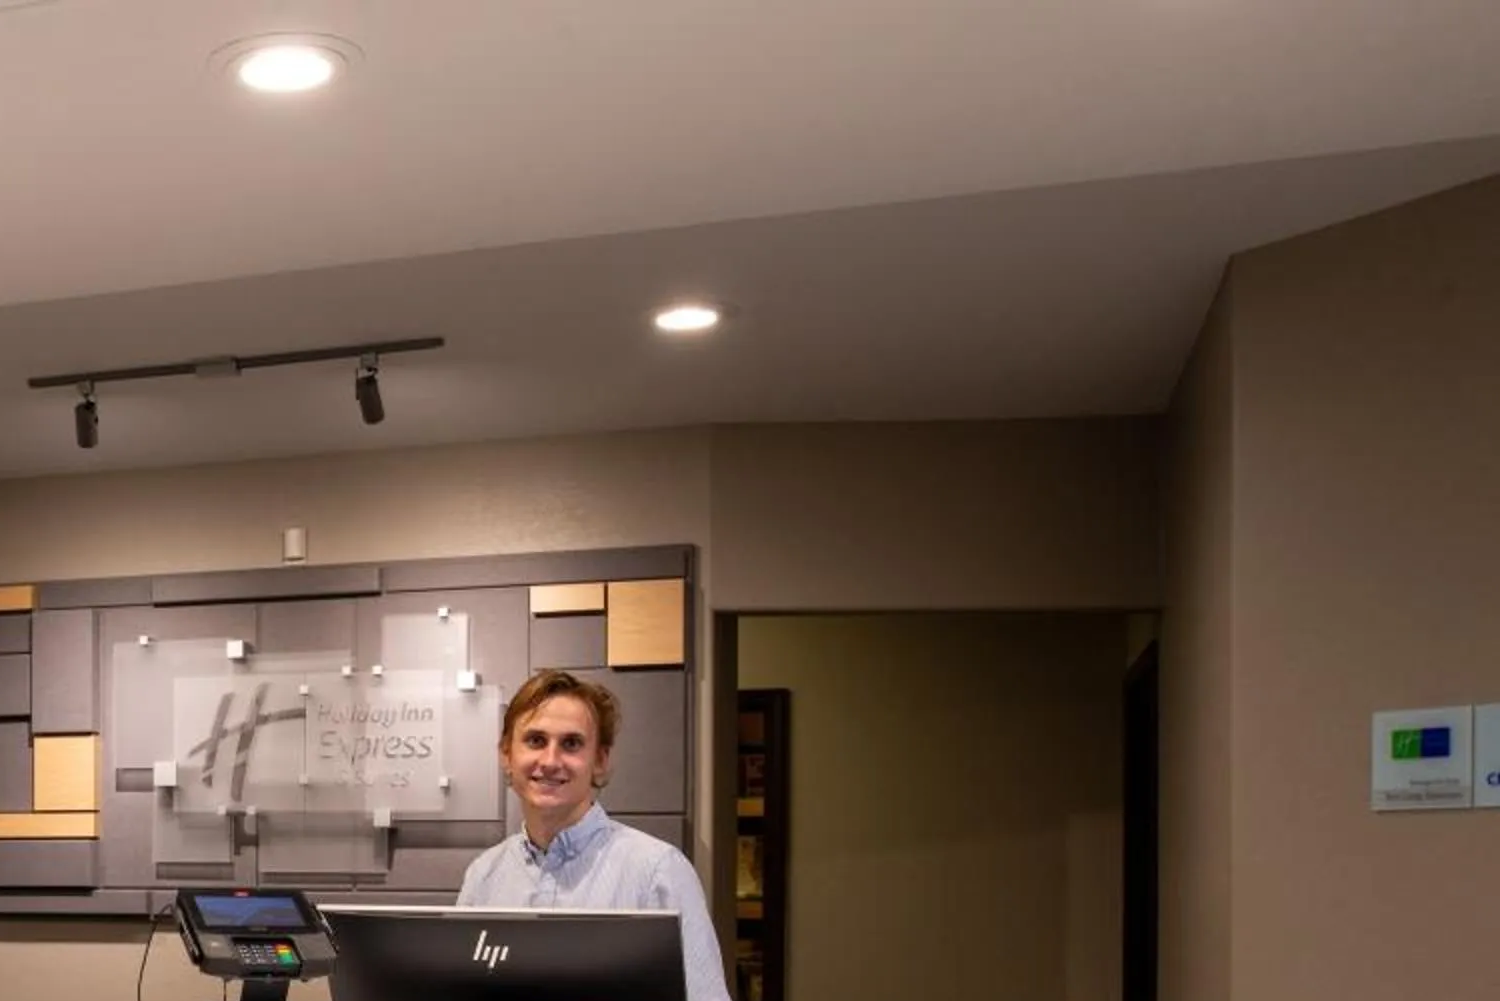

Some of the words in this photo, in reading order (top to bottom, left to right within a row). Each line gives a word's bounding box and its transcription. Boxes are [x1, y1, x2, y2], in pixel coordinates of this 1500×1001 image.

[401, 701, 433, 721] Inn
[321, 730, 434, 765] Express
[473, 929, 508, 969] hp
